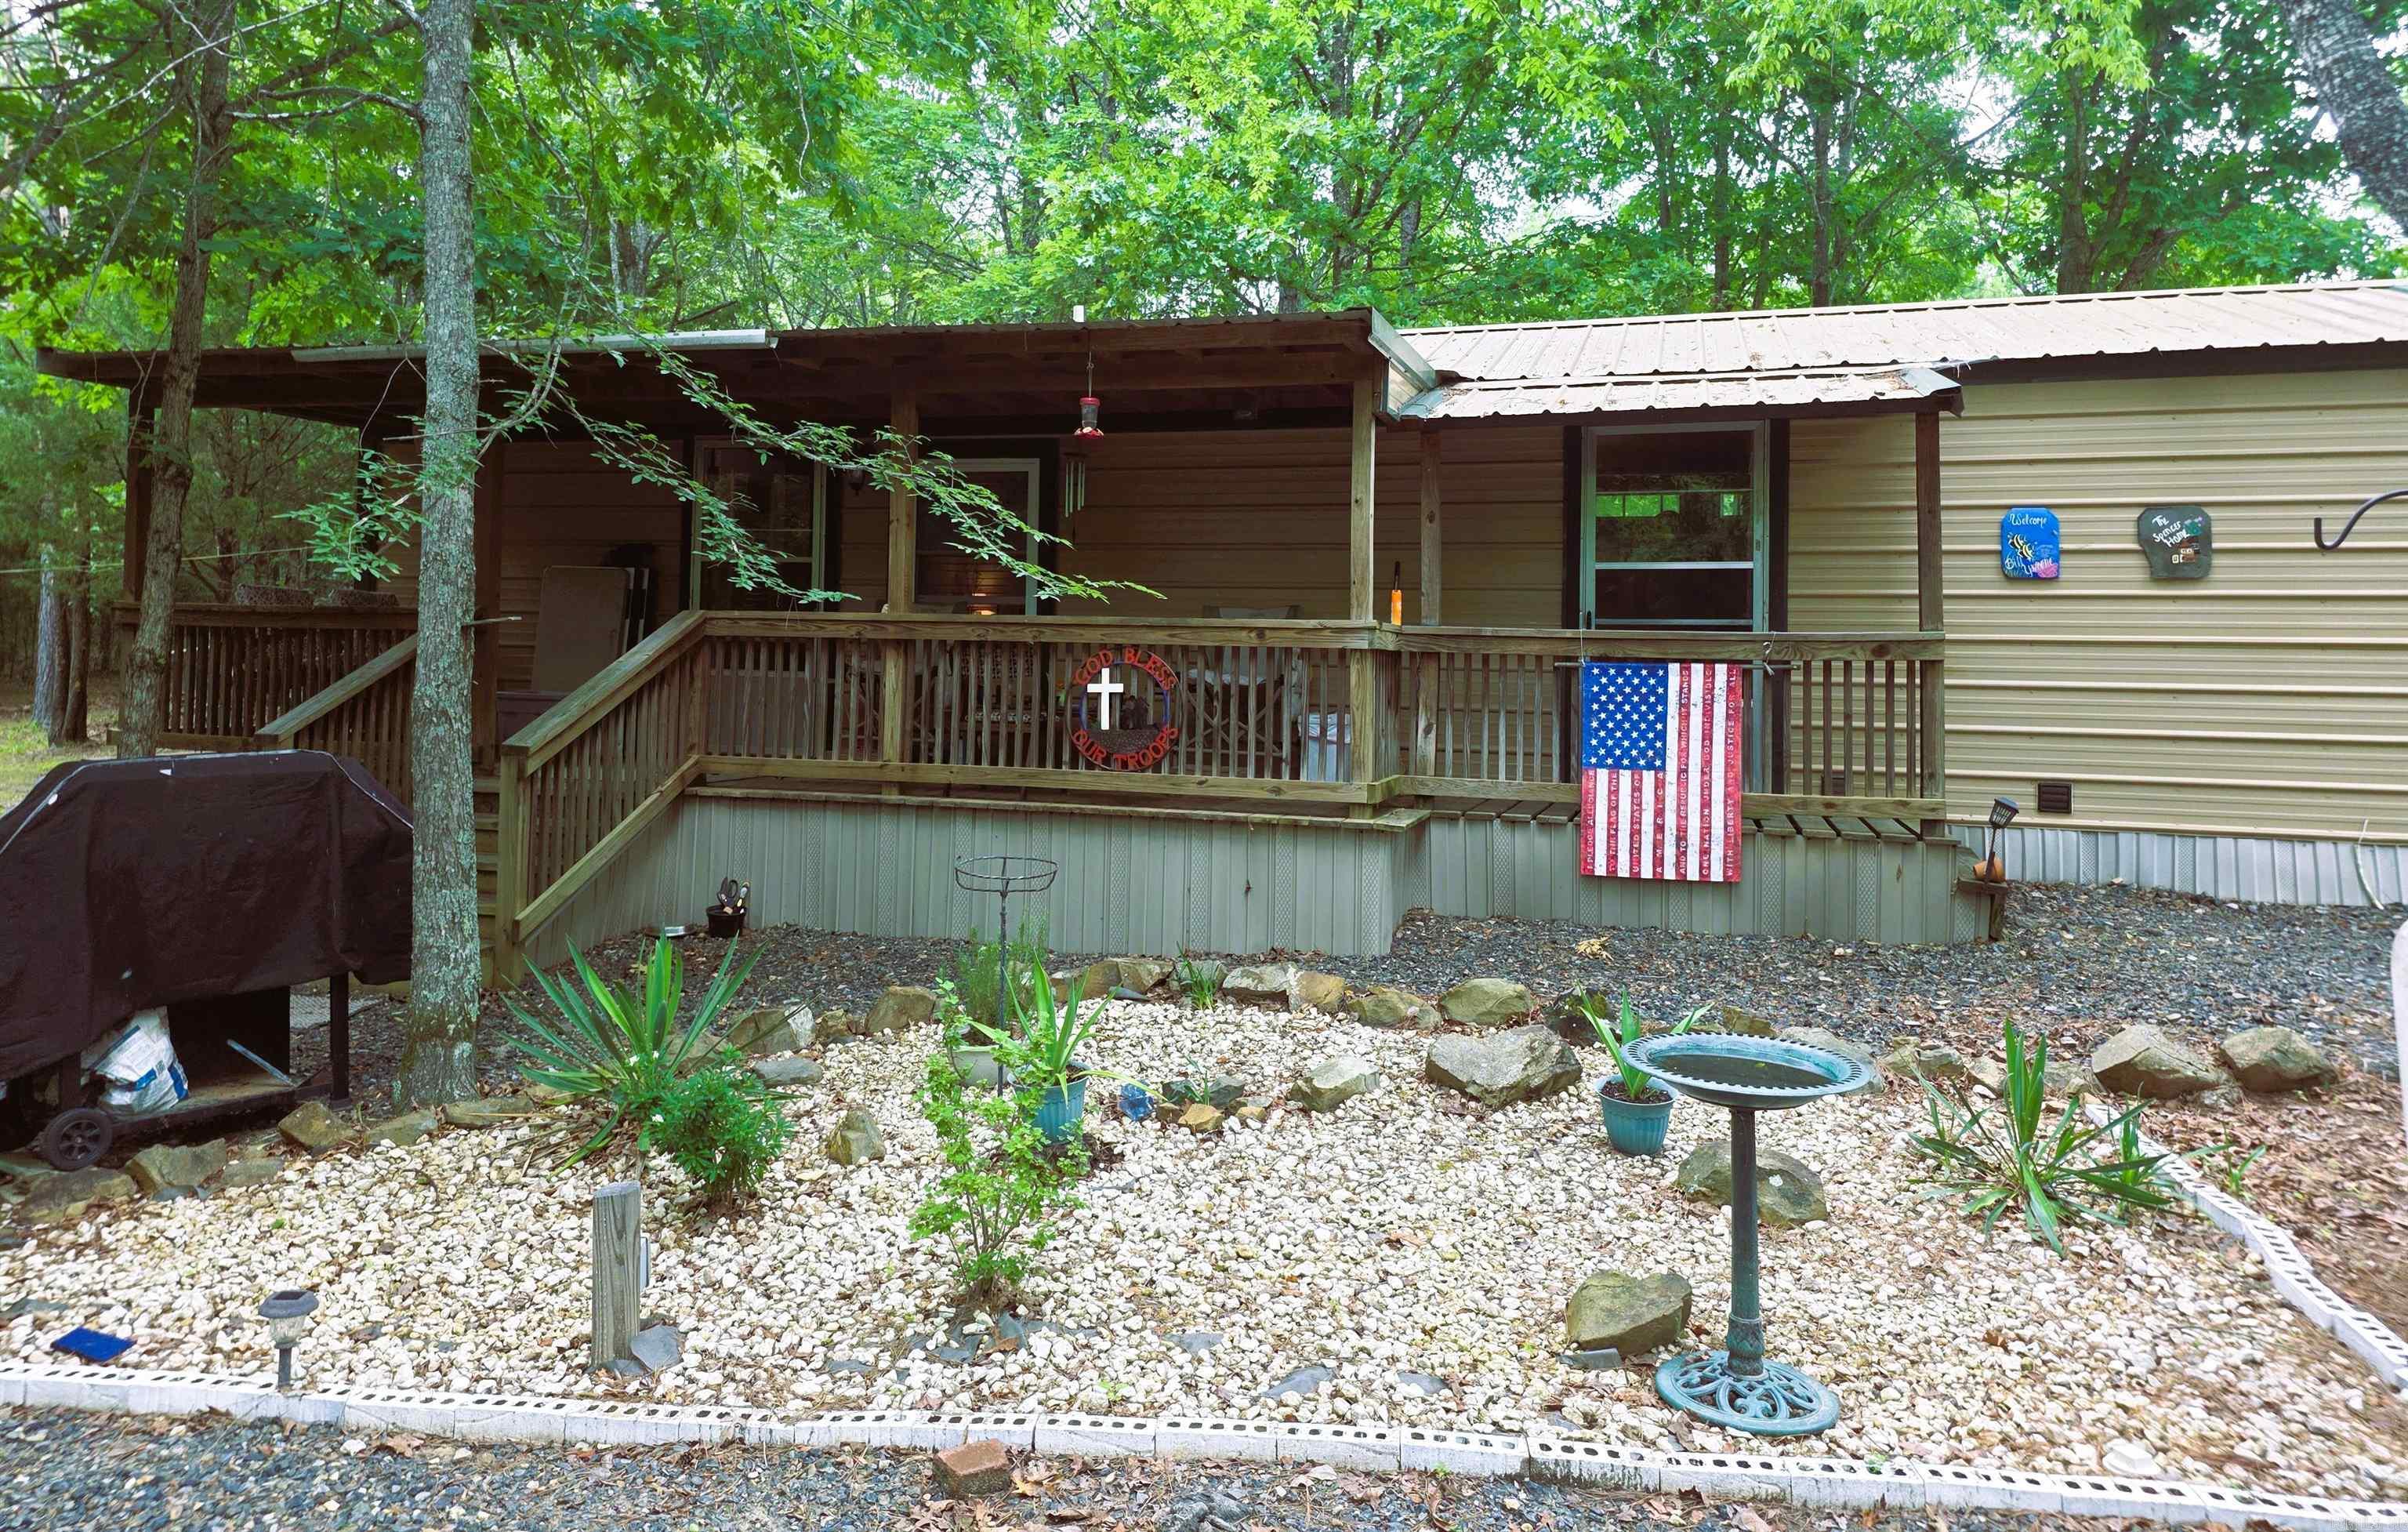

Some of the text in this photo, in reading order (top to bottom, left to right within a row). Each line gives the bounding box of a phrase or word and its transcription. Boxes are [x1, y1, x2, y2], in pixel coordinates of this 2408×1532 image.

[2007, 513, 2047, 528] Welcome
[2152, 514, 2170, 527] The
[2162, 528, 2190, 547] Home
[1075, 646, 1176, 690] GOD BLESS
[1681, 707, 1688, 716] IT
[1073, 727, 1179, 770] OUR TROOPS
[1633, 772, 1640, 786] OF
[1610, 794, 1617, 807] OF
[1680, 840, 1686, 852] TO
